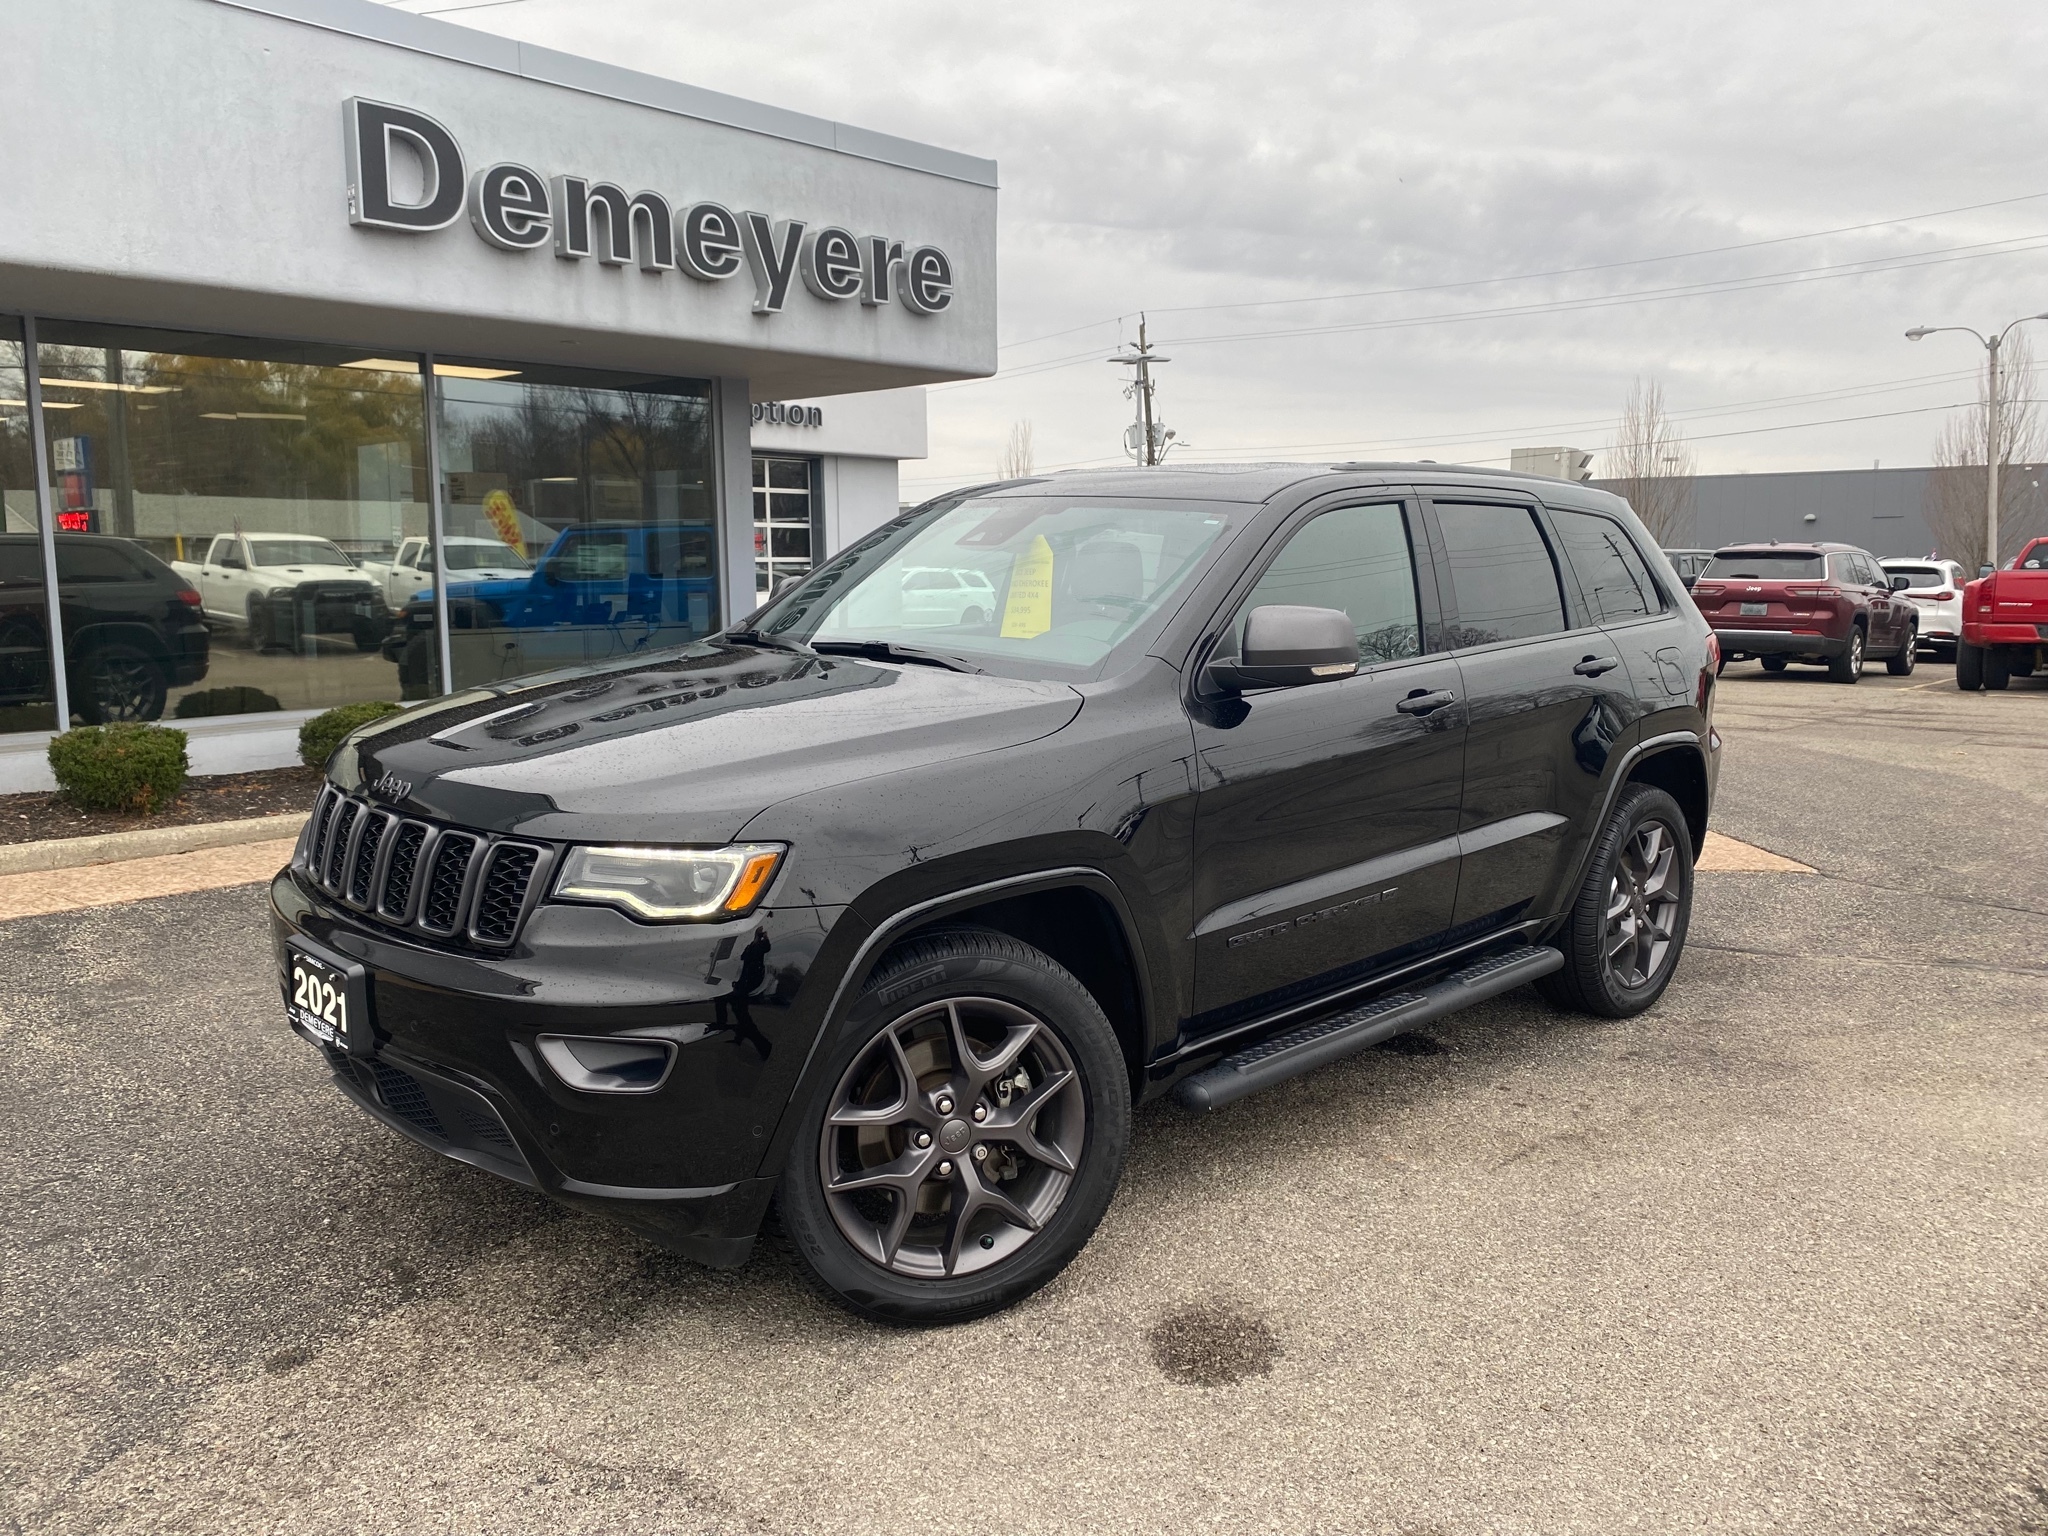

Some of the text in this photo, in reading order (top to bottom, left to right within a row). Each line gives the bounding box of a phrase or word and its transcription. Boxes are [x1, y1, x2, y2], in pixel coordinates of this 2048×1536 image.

[345, 95, 955, 315] Demeyere
[750, 401, 823, 427] ption
[371, 769, 411, 804] Jeep
[1227, 921, 1290, 949] GRAND
[1295, 890, 1386, 928] CHEROKEE
[293, 966, 347, 1034] 2021
[877, 964, 947, 1007] PIRELLI
[299, 1009, 335, 1038] DEMEYERE
[944, 1126, 965, 1146] Jeep
